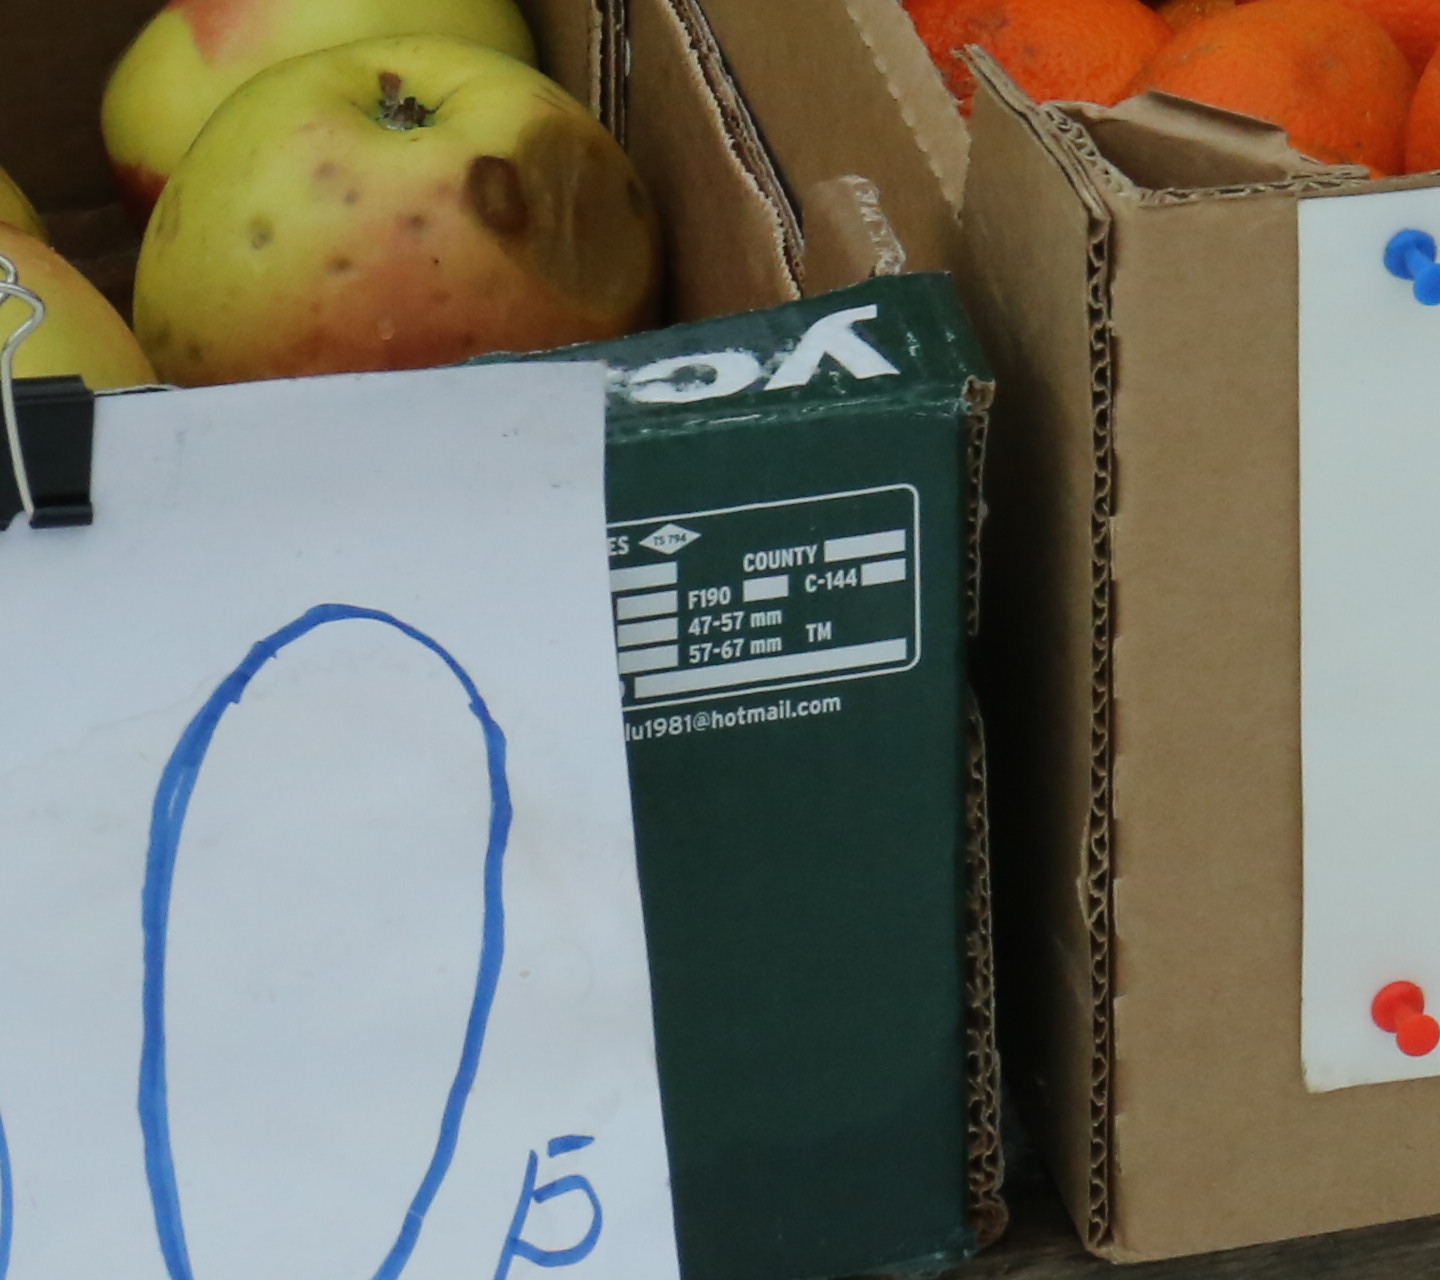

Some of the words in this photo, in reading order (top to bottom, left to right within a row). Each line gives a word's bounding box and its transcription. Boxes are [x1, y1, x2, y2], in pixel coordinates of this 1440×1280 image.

[742, 544, 819, 573] COUNTY
[804, 568, 858, 593] C-144
[687, 585, 732, 610] F190
[688, 610, 745, 637] 47-57
[750, 608, 783, 629] mm
[805, 620, 833, 644] TM
[688, 638, 745, 664] 57-67
[750, 636, 783, 656] mm
